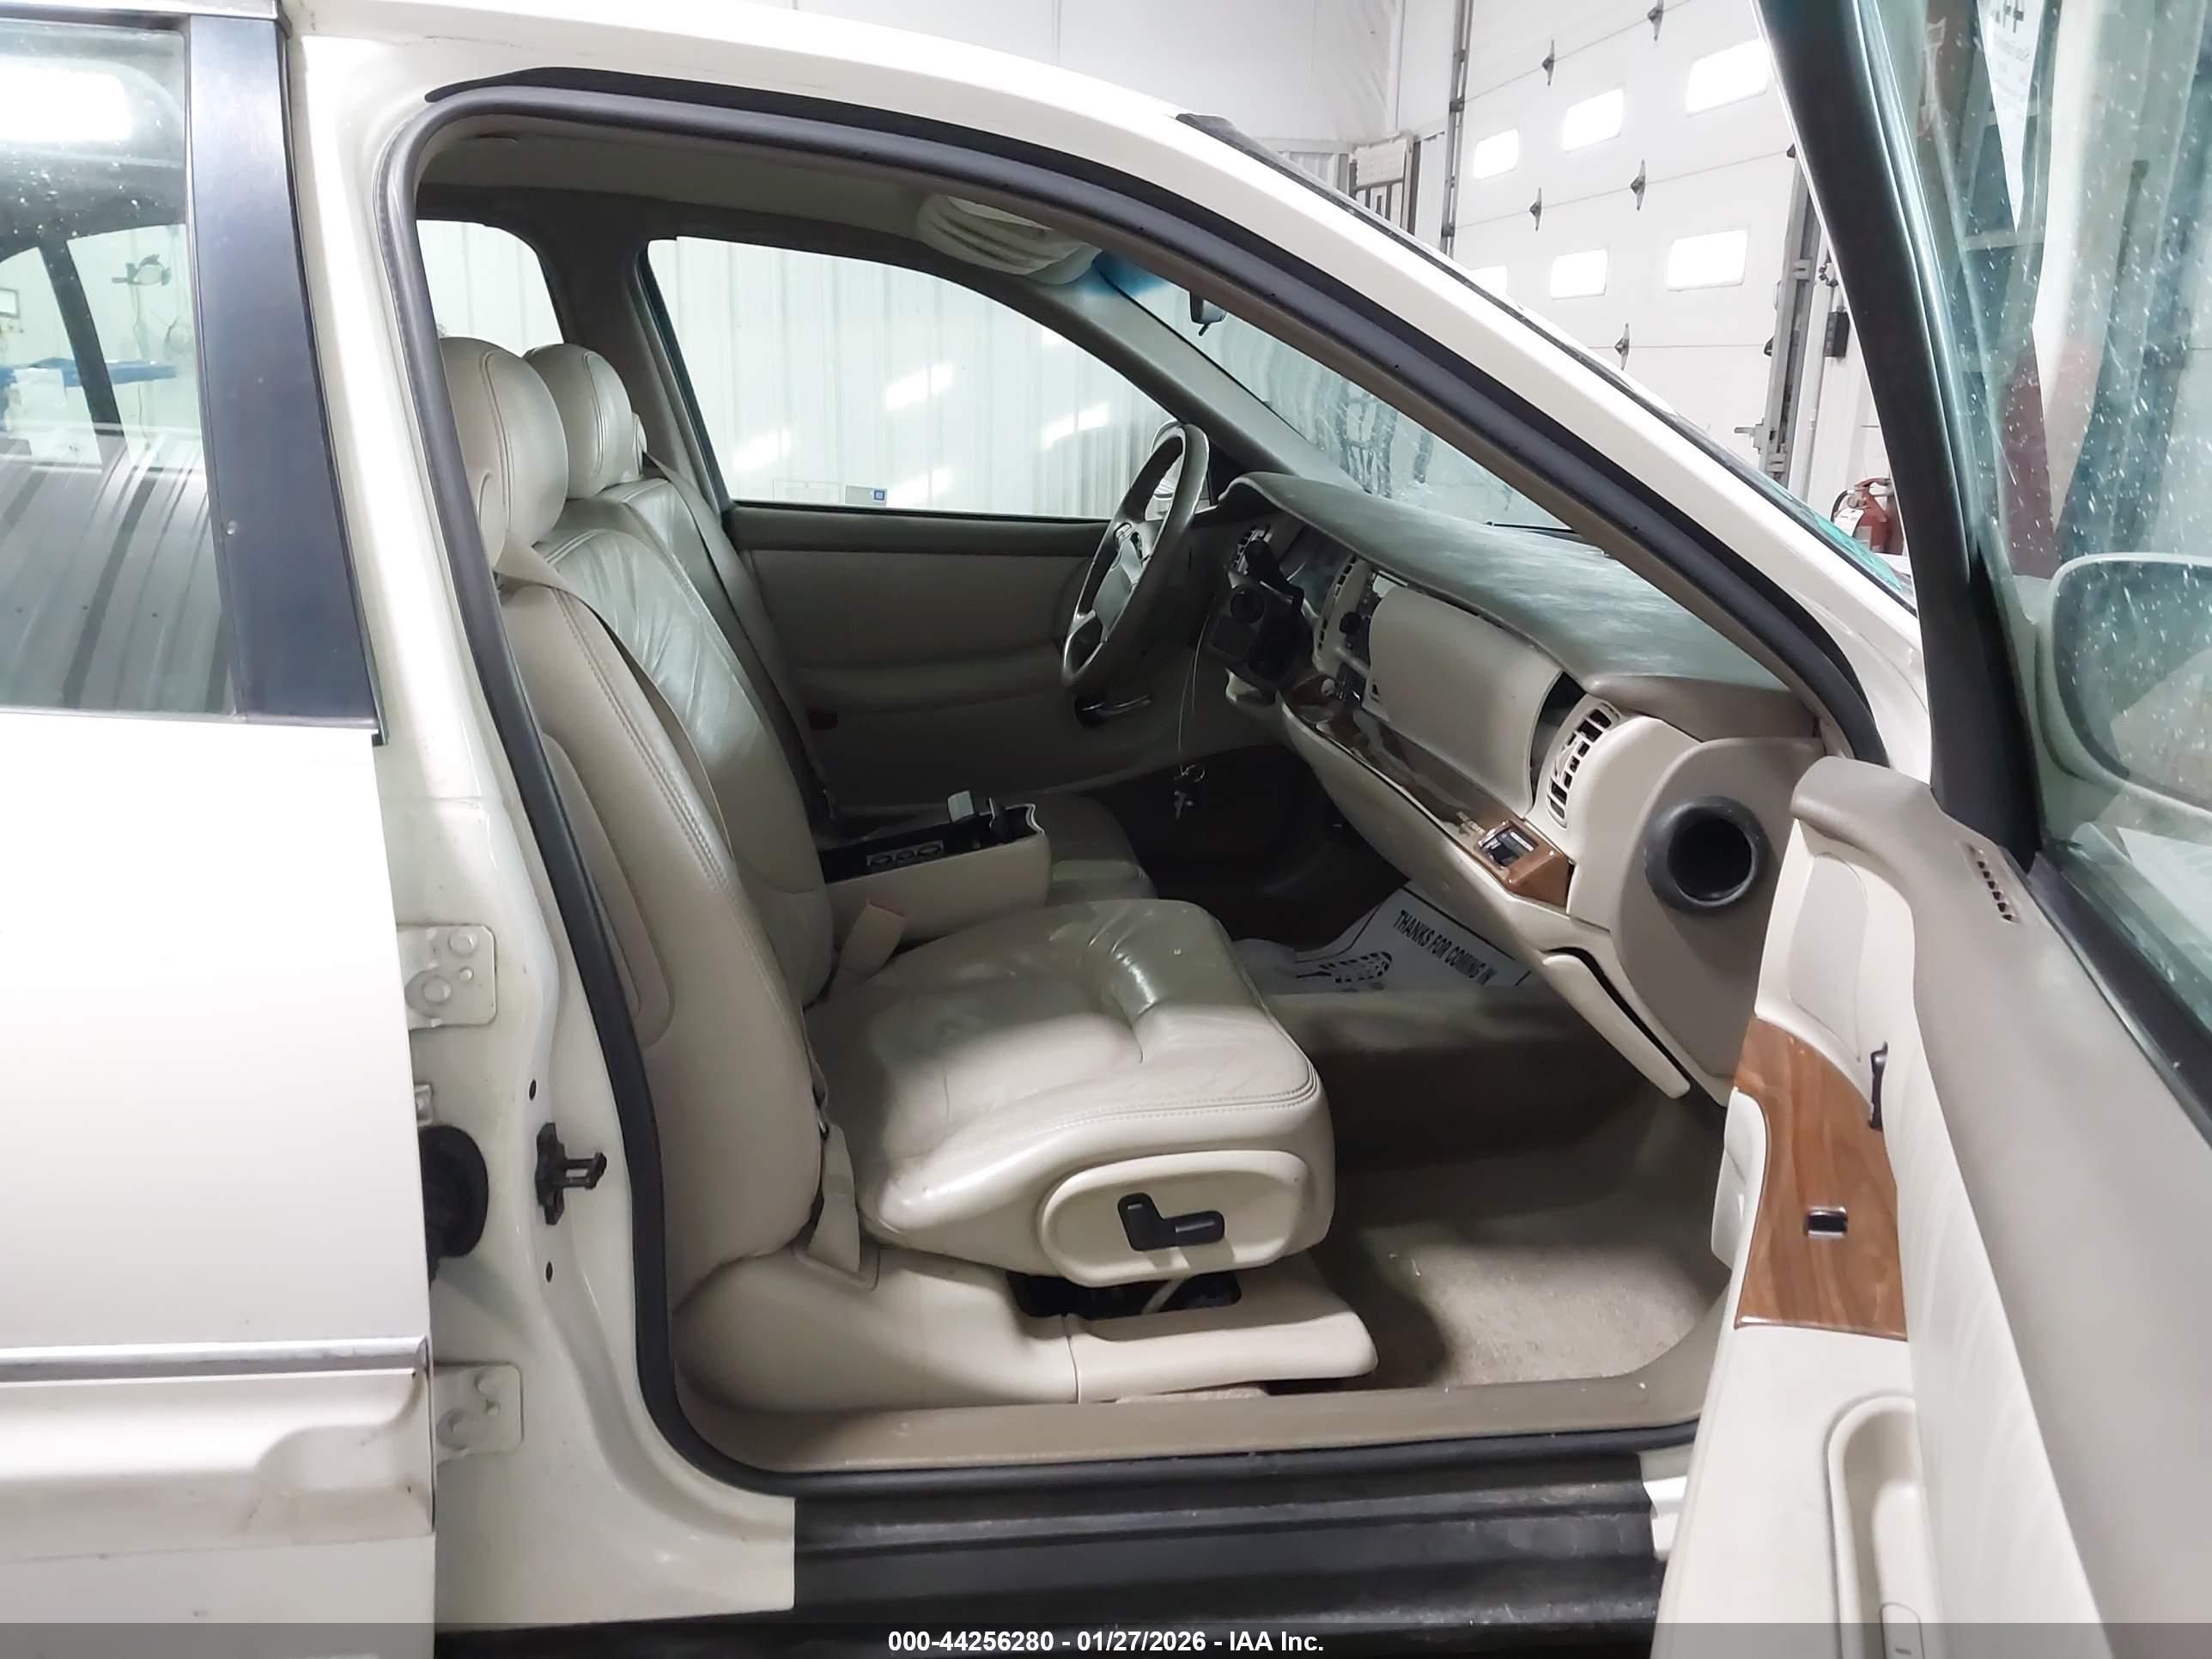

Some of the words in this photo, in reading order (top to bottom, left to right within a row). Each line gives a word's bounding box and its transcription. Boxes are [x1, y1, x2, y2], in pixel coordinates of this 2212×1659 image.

[1393, 909, 1436, 947] THANKS
[1427, 934, 1452, 959] FOR
[1444, 946, 1486, 979] COMING
[1476, 967, 1498, 986] IN
